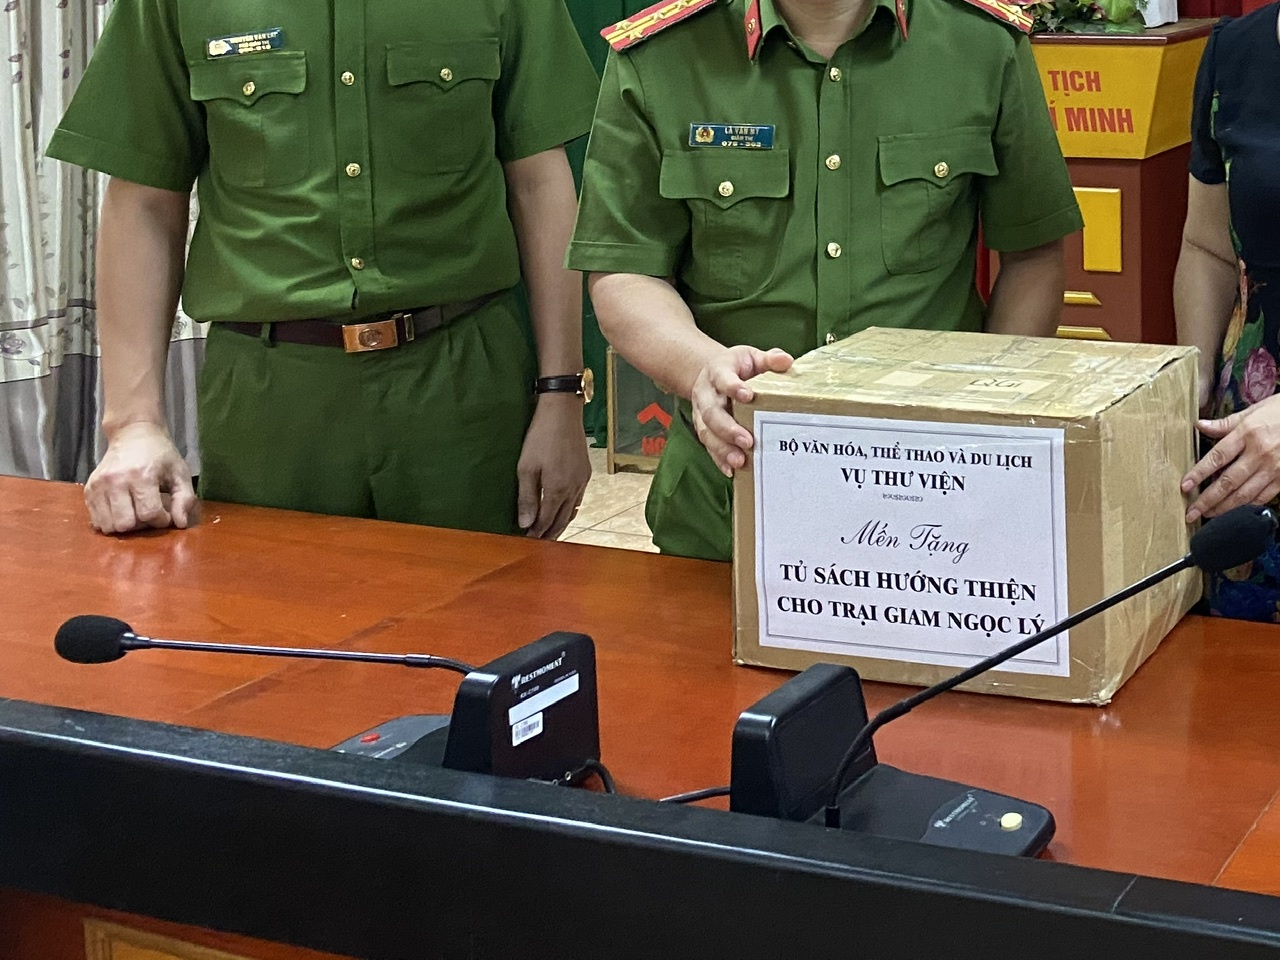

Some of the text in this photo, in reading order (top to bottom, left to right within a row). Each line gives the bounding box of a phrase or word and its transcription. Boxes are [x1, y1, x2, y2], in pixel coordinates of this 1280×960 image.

[1047, 70, 1102, 97] TỊCH
[1064, 107, 1135, 134] MINH
[779, 438, 1033, 471] BỘ VĂN HÓA, THỂ THAO VÀ DU LỊCH
[840, 467, 966, 496] VỤ THƯ VIỆN
[840, 519, 970, 564] Mến Tặng
[779, 559, 1037, 606] TỦ SÁCH HƯỚNG THIỆN
[777, 595, 1046, 638] CHO TRẠI GIAM NGỌC LÝ
